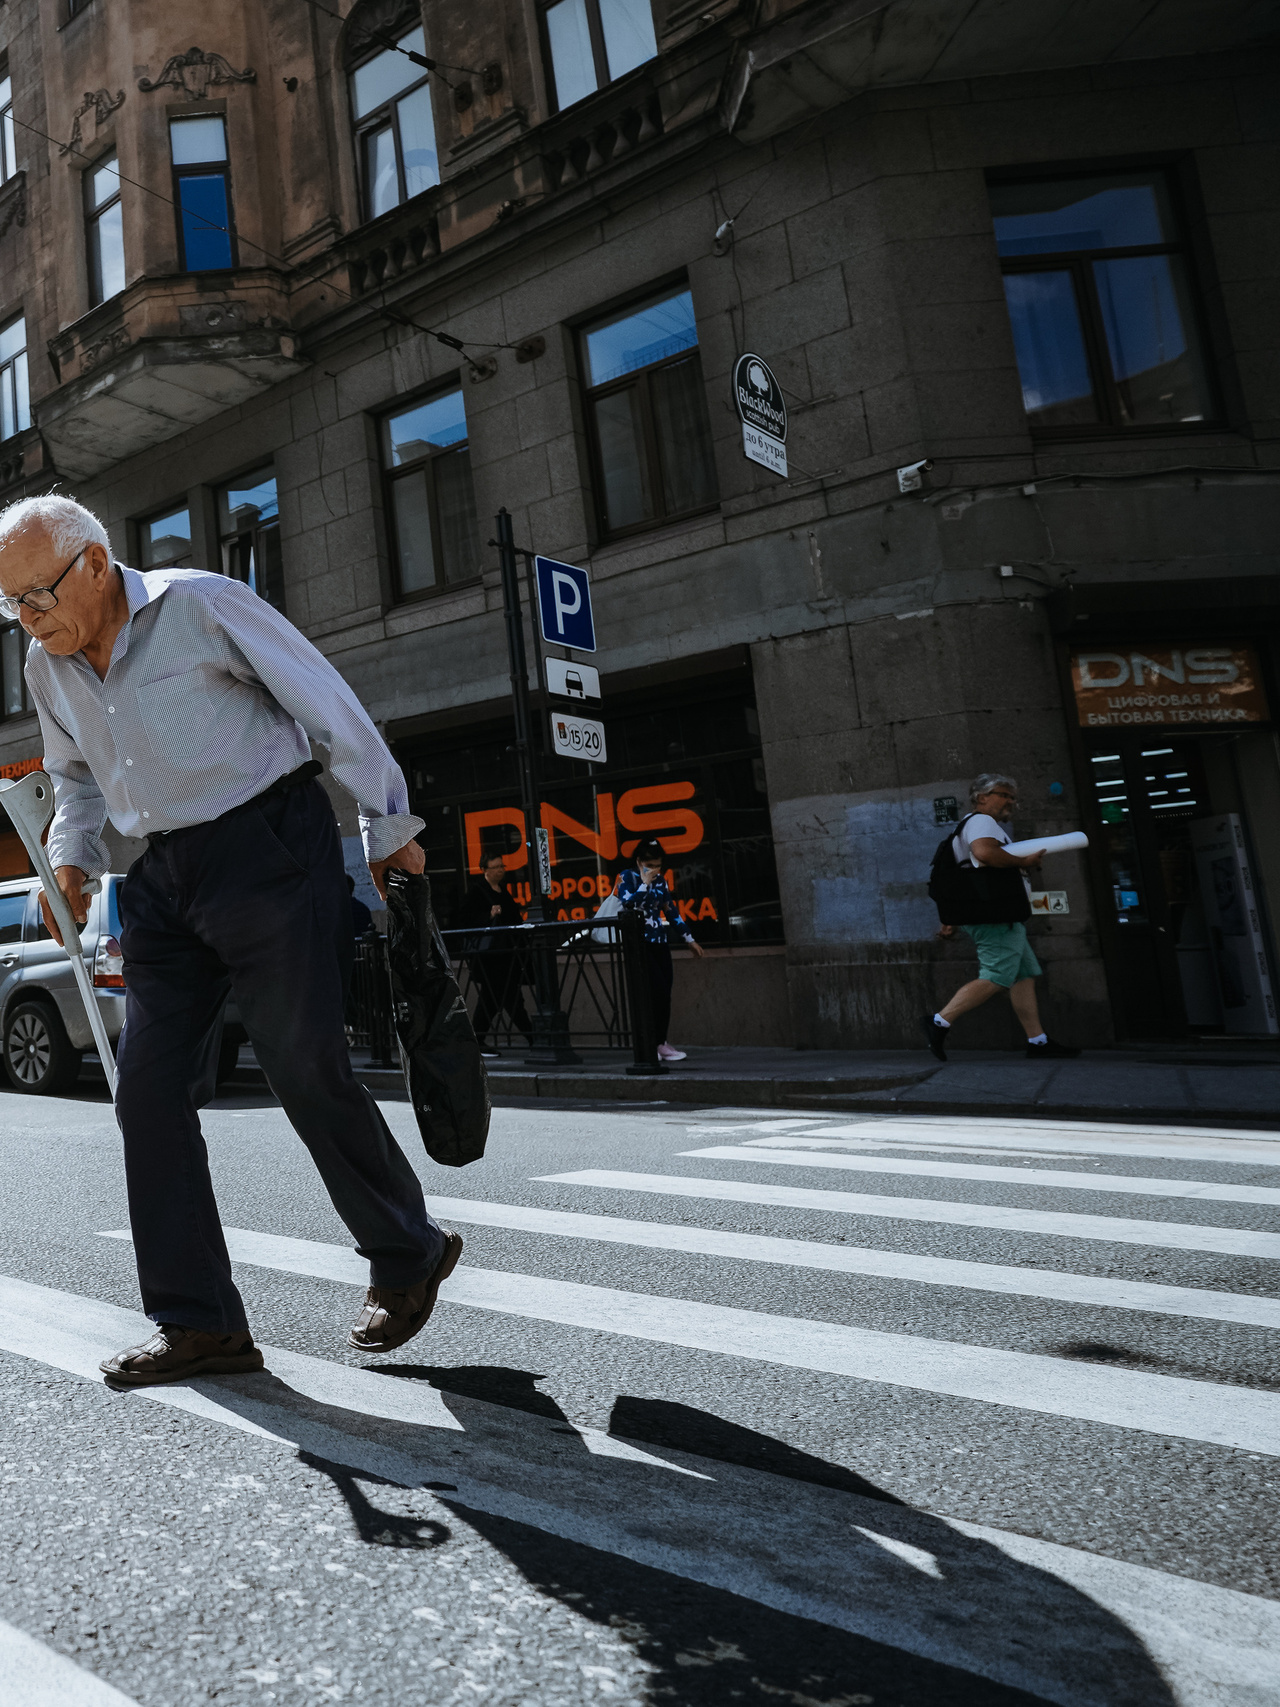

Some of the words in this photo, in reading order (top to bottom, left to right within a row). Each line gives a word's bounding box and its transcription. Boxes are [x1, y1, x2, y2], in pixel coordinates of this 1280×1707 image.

[738, 385, 784, 426] BlackWood
[746, 409, 768, 427] scottish
[768, 422, 780, 434] pub
[746, 431, 756, 444] до
[757, 435, 763, 448] 6
[764, 441, 786, 460] утра
[552, 570, 581, 635] P
[1077, 648, 1240, 689] DNS
[1107, 693, 1204, 710] ЦИФРОВАЯ
[1206, 692, 1220, 705] И
[1087, 710, 1165, 726] БЫТОВАЯ
[1169, 708, 1249, 722] ТЕХНИКА
[571, 729, 581, 744] 15
[584, 730, 600, 749] 20
[464, 781, 704, 876] DNS
